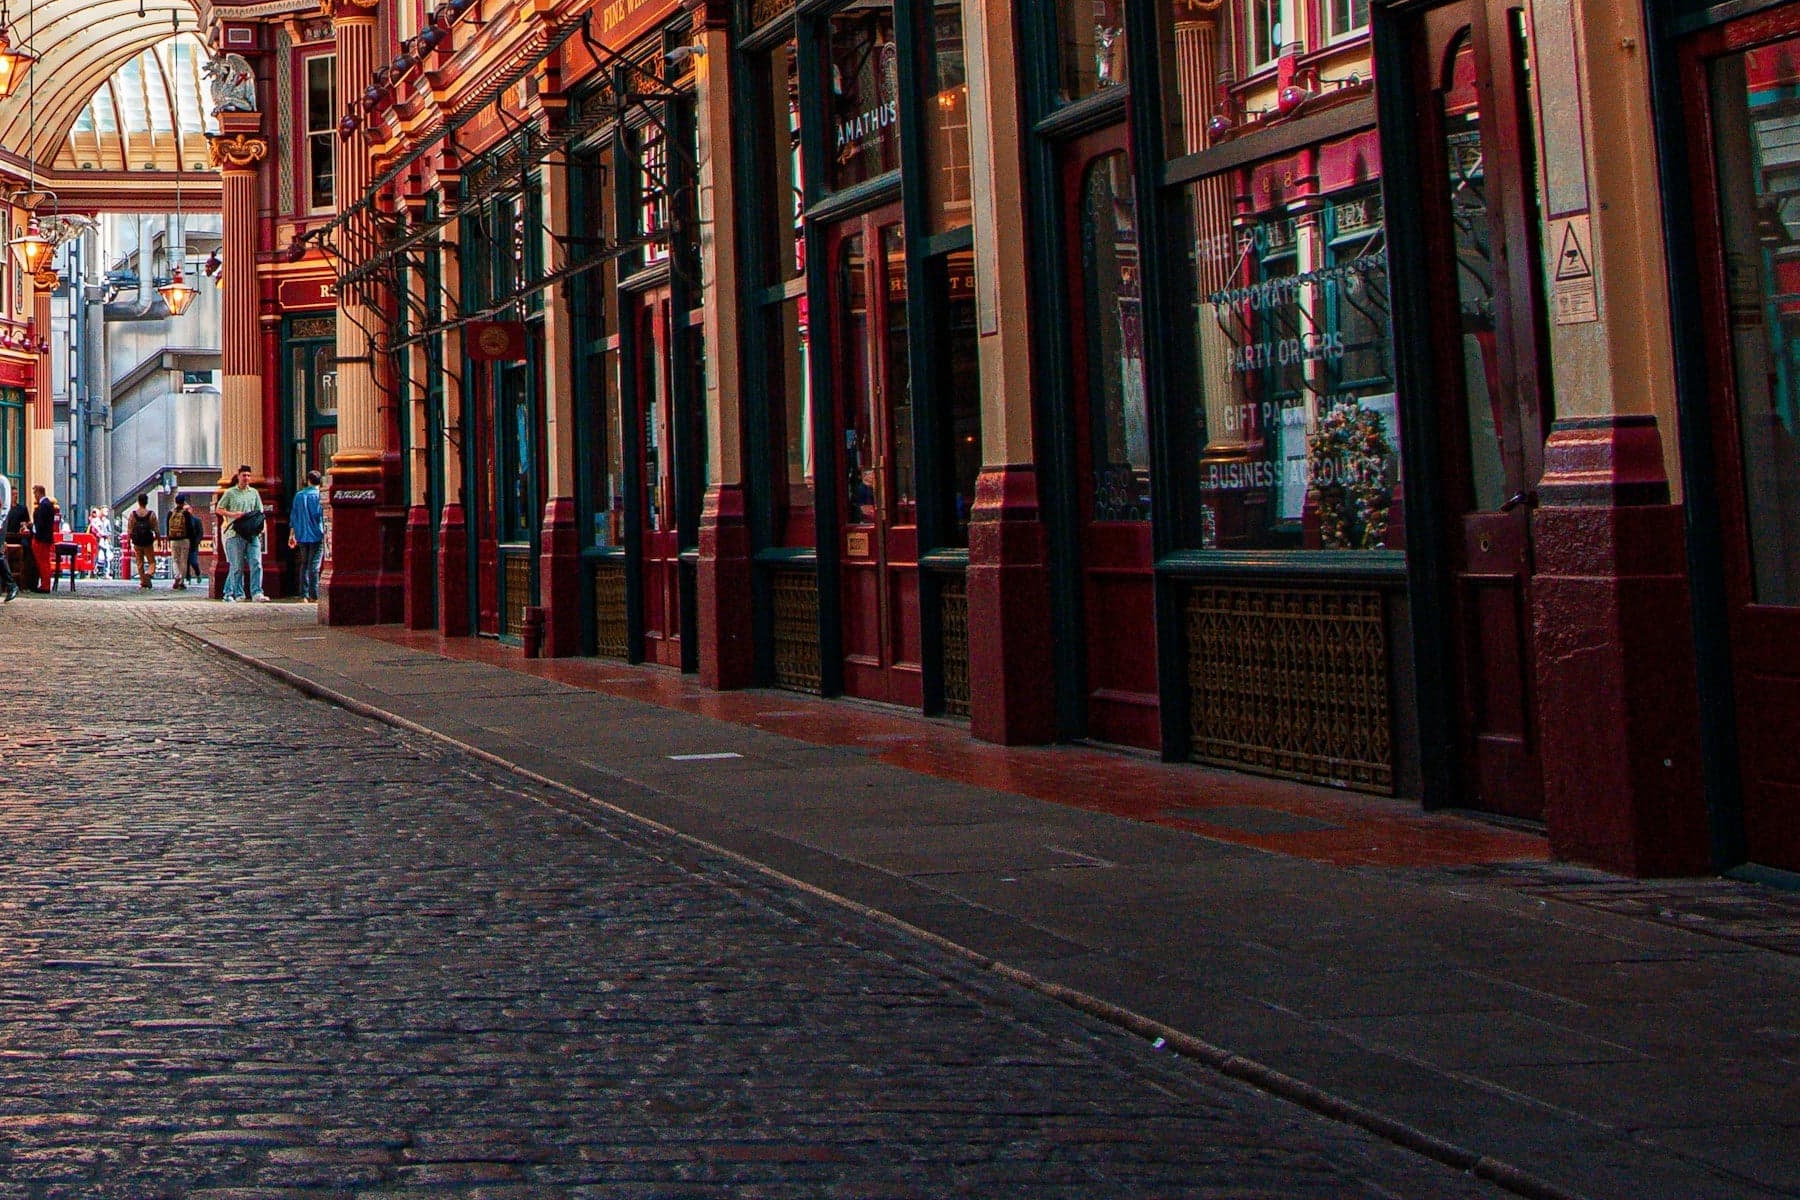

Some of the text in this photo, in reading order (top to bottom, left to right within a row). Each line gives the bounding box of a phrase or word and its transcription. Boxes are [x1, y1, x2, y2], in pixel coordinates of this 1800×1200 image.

[836, 100, 897, 148] AMATHUS
[1226, 340, 1273, 371] PARTY
[1223, 402, 1257, 433] GIFT
[1208, 459, 1284, 489] BUSINESS
